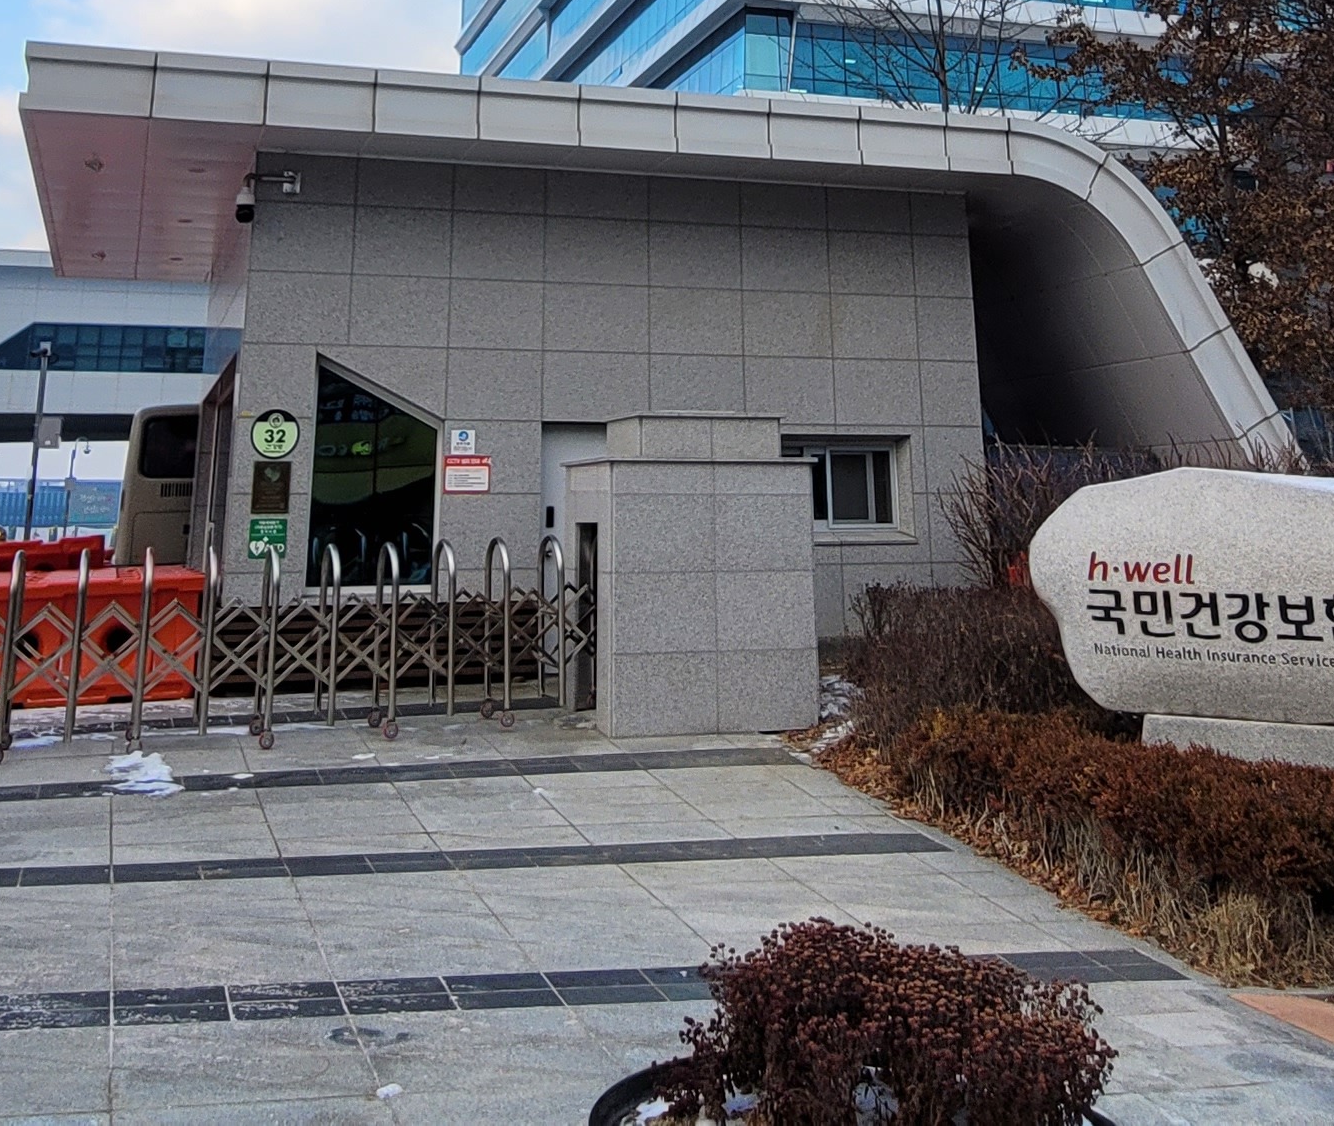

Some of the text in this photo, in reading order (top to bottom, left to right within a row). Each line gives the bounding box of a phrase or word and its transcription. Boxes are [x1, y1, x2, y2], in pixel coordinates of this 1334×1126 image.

[264, 429, 286, 444] 32
[1093, 642, 1151, 659] National
[1155, 646, 1202, 661] Health
[1207, 649, 1276, 665] Insurance
